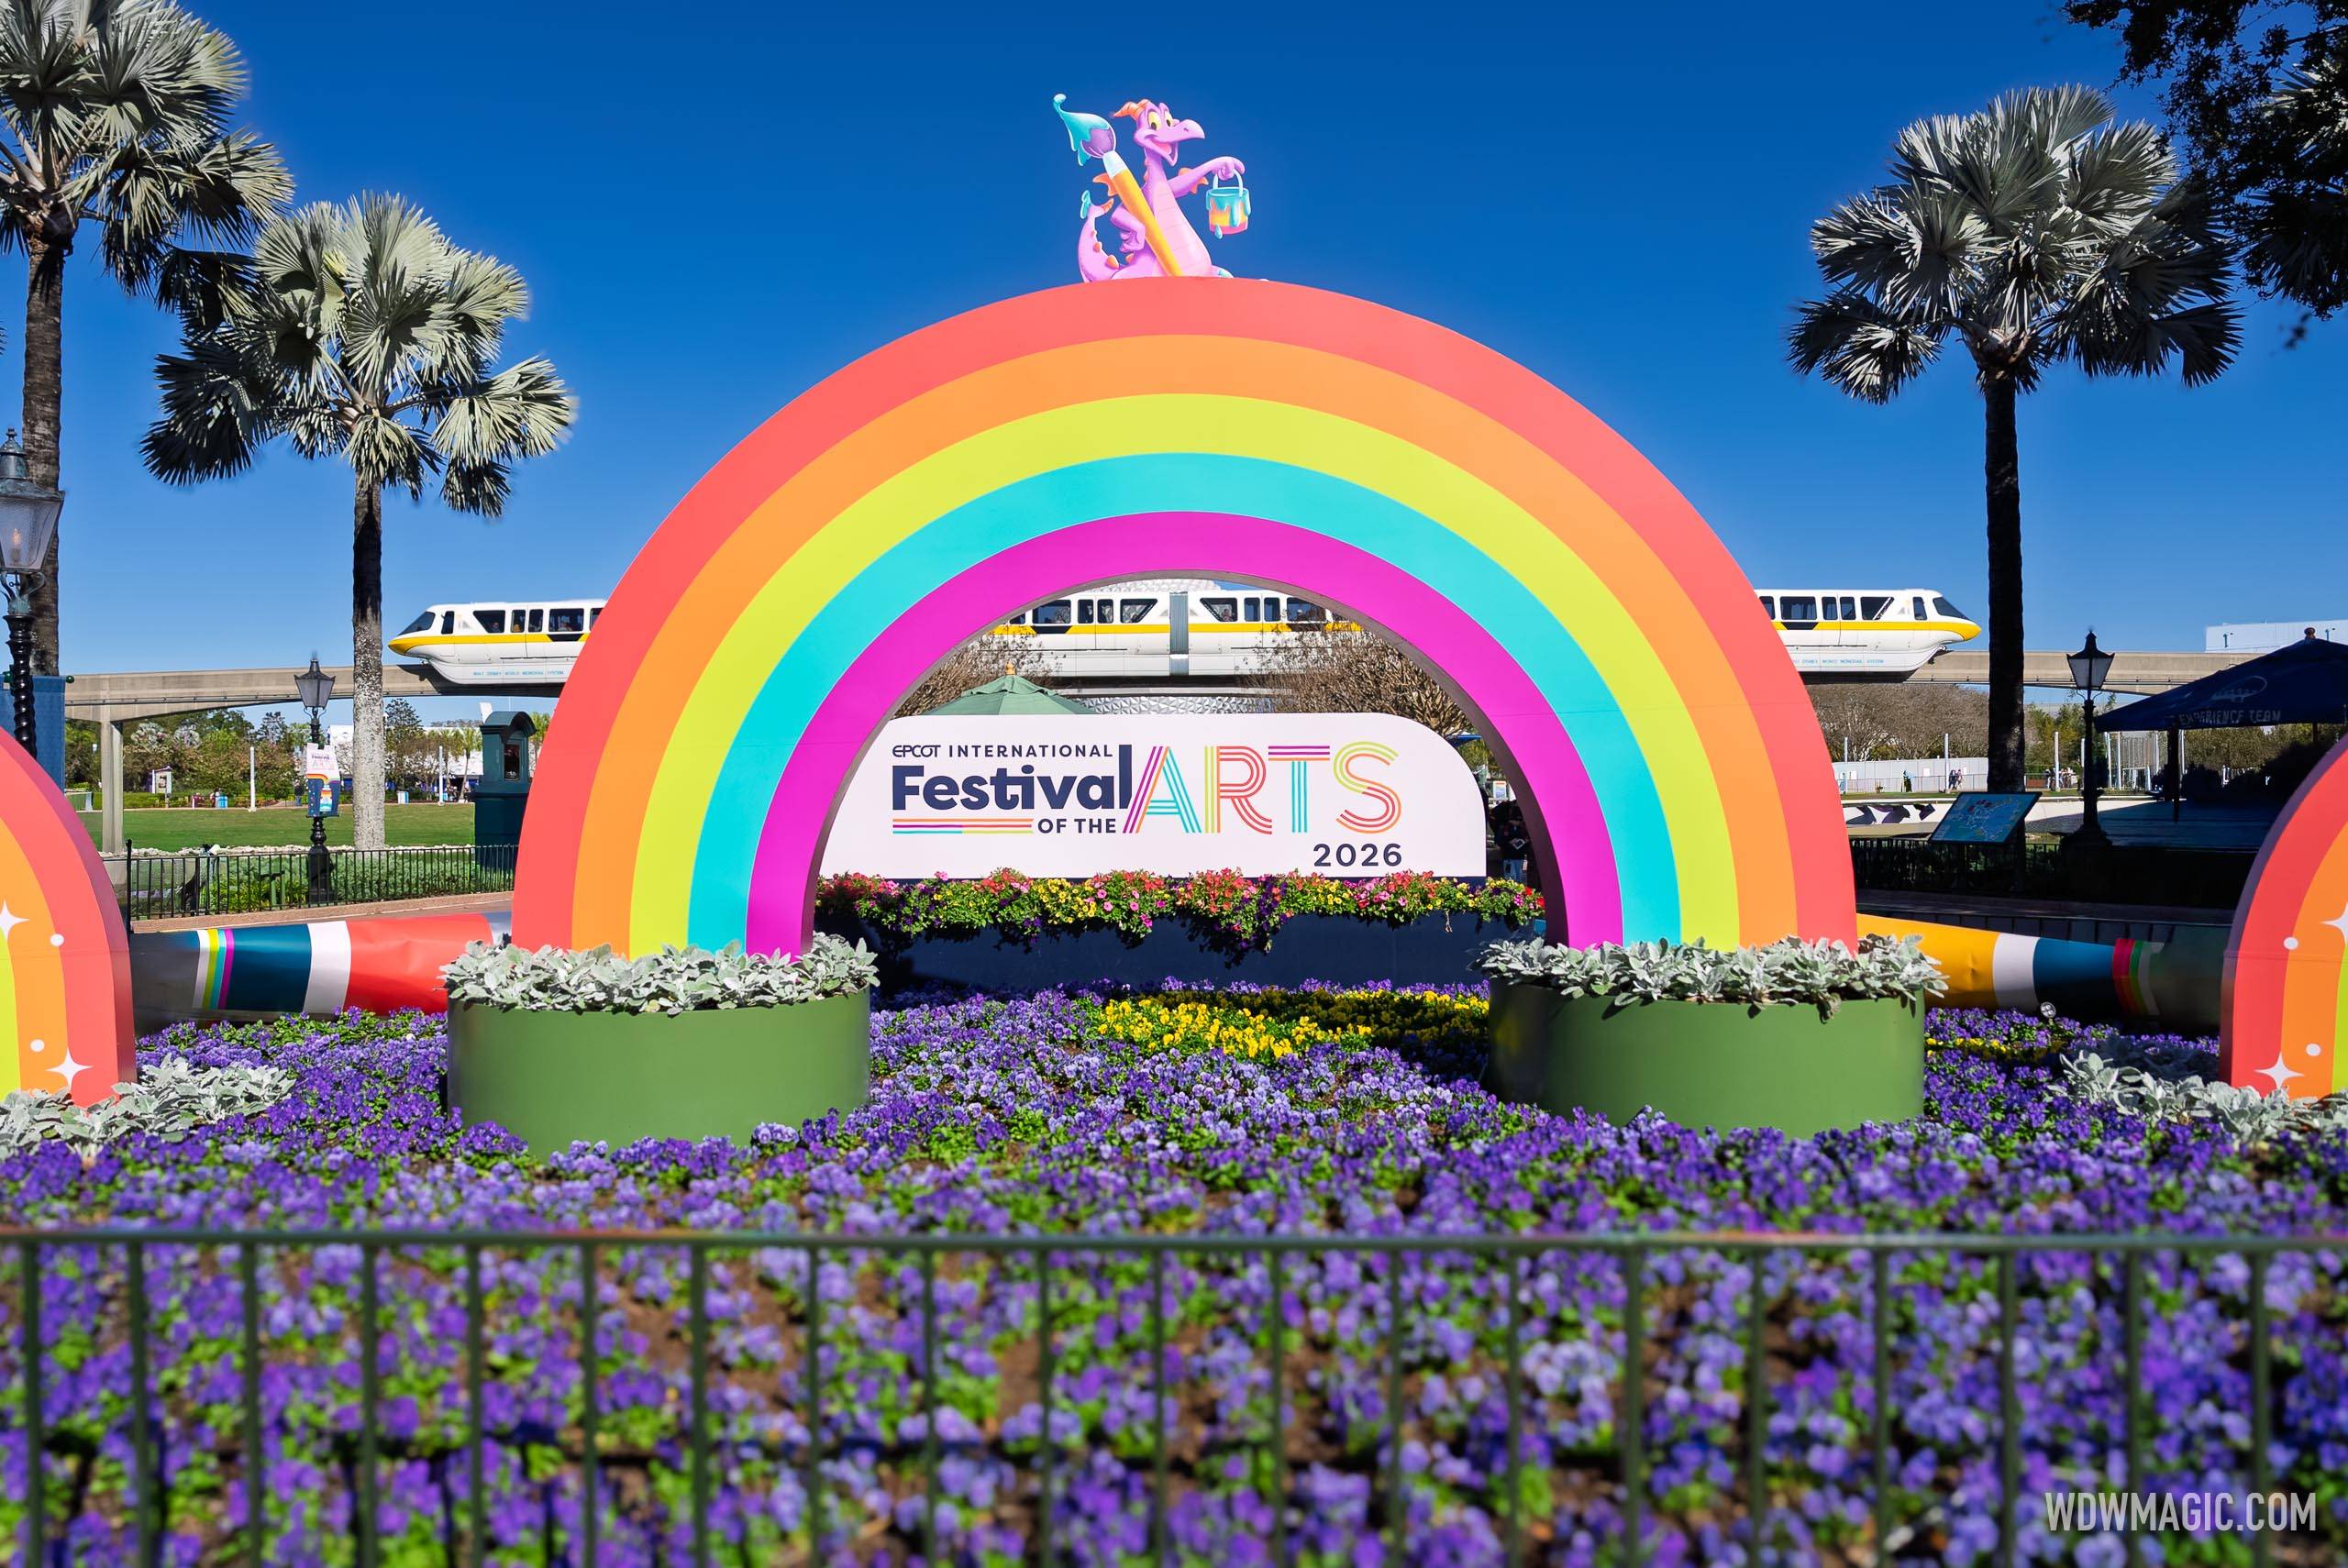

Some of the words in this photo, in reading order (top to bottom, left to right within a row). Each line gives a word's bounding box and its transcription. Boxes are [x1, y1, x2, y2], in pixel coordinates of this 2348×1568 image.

[2248, 709, 2282, 724] TEAM
[892, 745, 941, 757] EPCOT
[948, 745, 1113, 757] INTERNATIONAL
[892, 744, 1133, 811] Festival
[1122, 741, 1401, 834] ARTS
[1037, 818, 1067, 834] OF
[1074, 818, 1116, 834] THE
[1312, 843, 1402, 867] 2026
